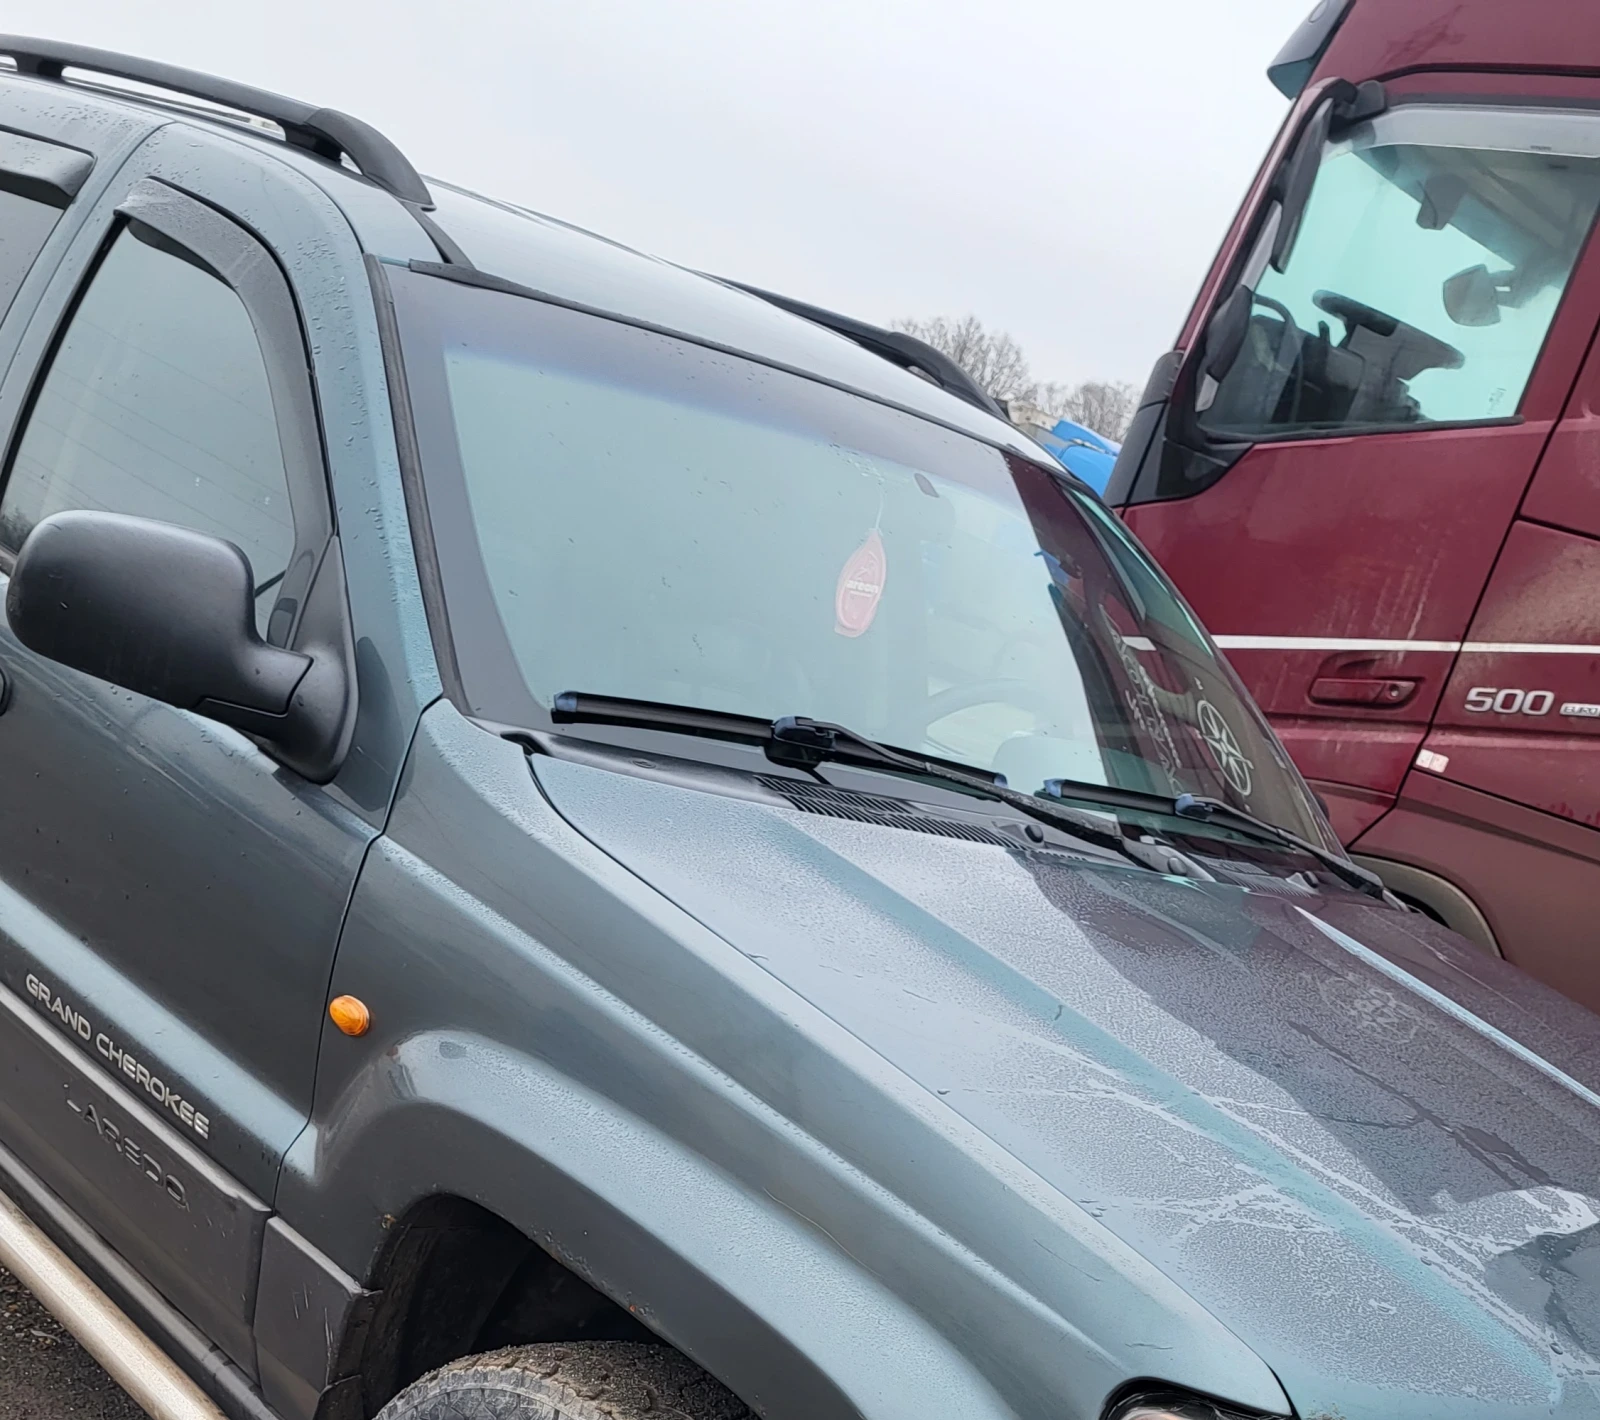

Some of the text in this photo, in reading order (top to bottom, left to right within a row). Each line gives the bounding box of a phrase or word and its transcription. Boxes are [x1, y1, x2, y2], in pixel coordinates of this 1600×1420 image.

[1464, 687, 1555, 716] 500
[26, 973, 209, 1140] GRAND CHEROKEE
[63, 1083, 190, 1211] LAREDO
